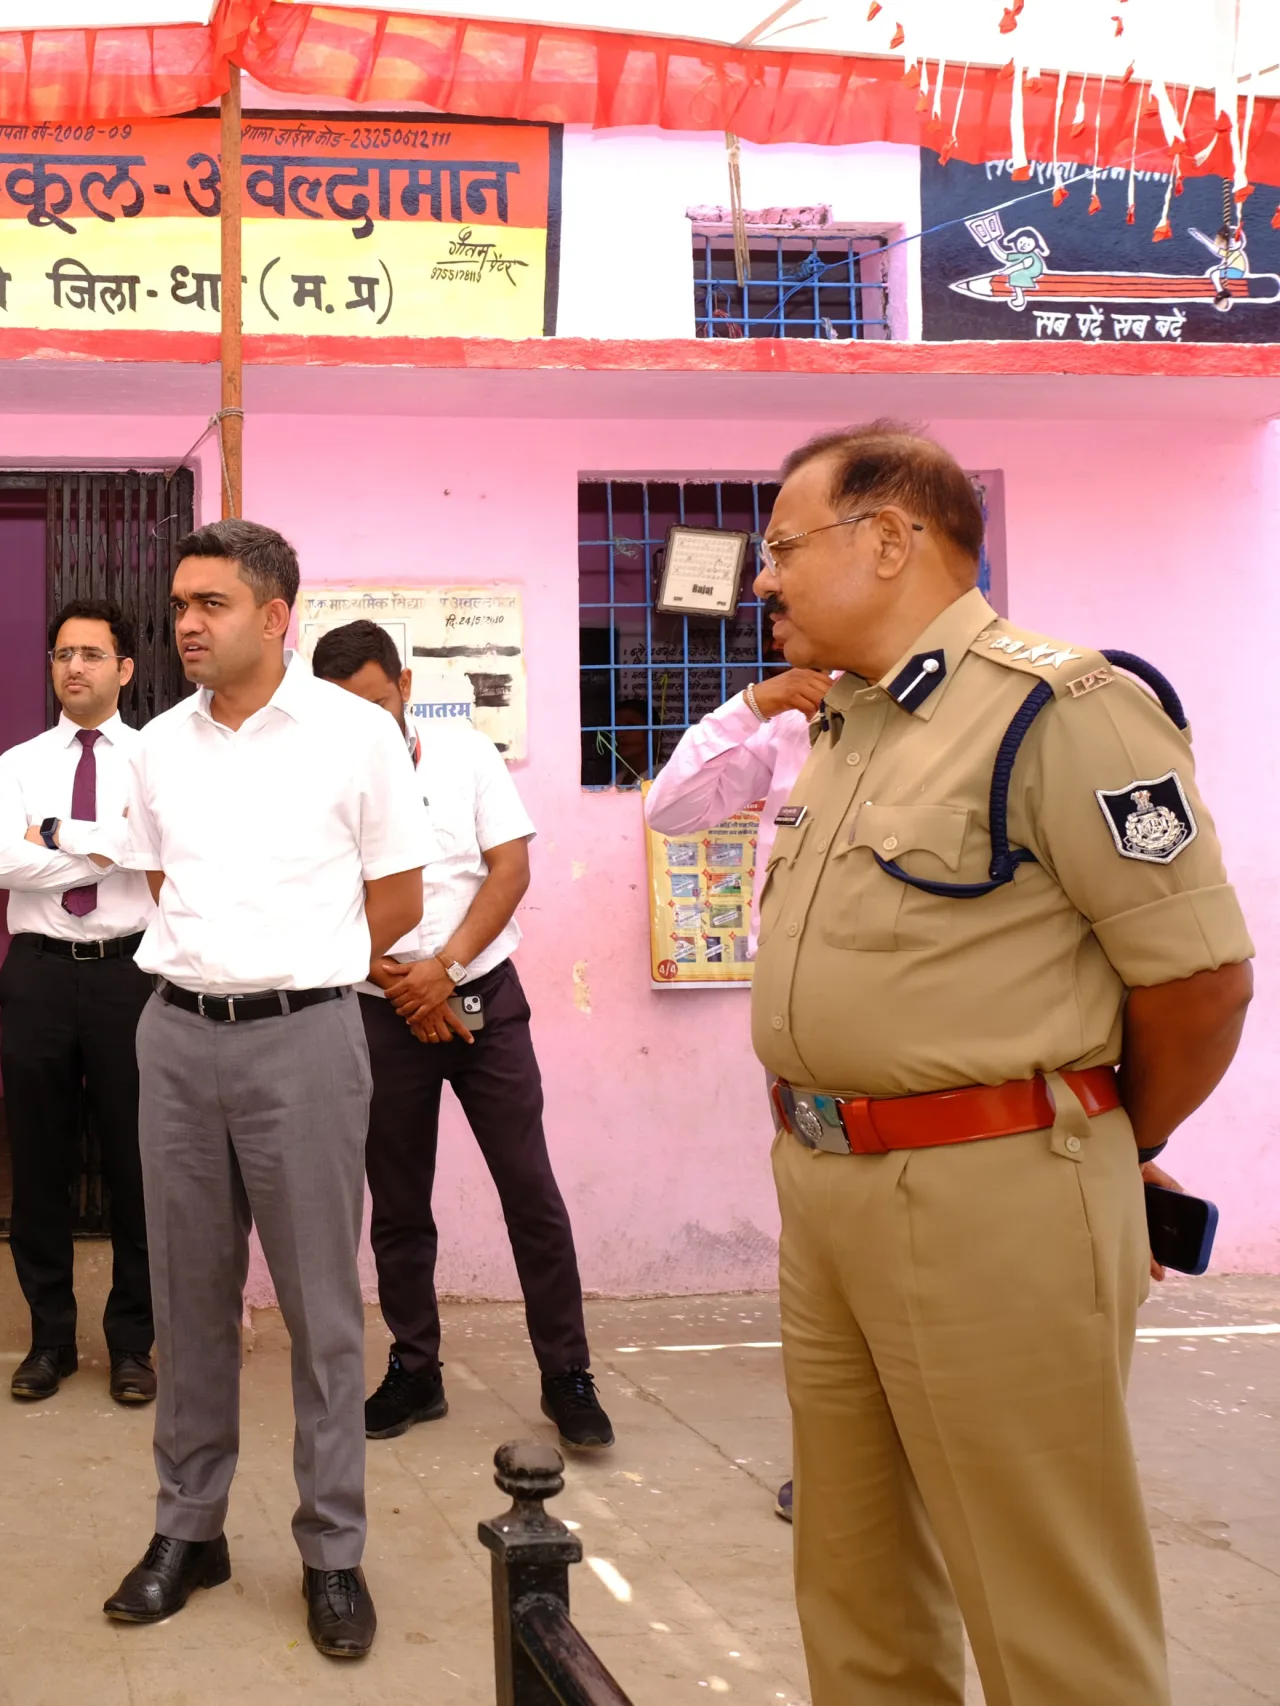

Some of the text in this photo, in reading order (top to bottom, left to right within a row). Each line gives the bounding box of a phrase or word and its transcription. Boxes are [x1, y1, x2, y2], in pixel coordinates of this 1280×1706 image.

[1032, 311, 1071, 337] सब
[1110, 313, 1151, 339] सब
[413, 702, 475, 724] मातरम्
